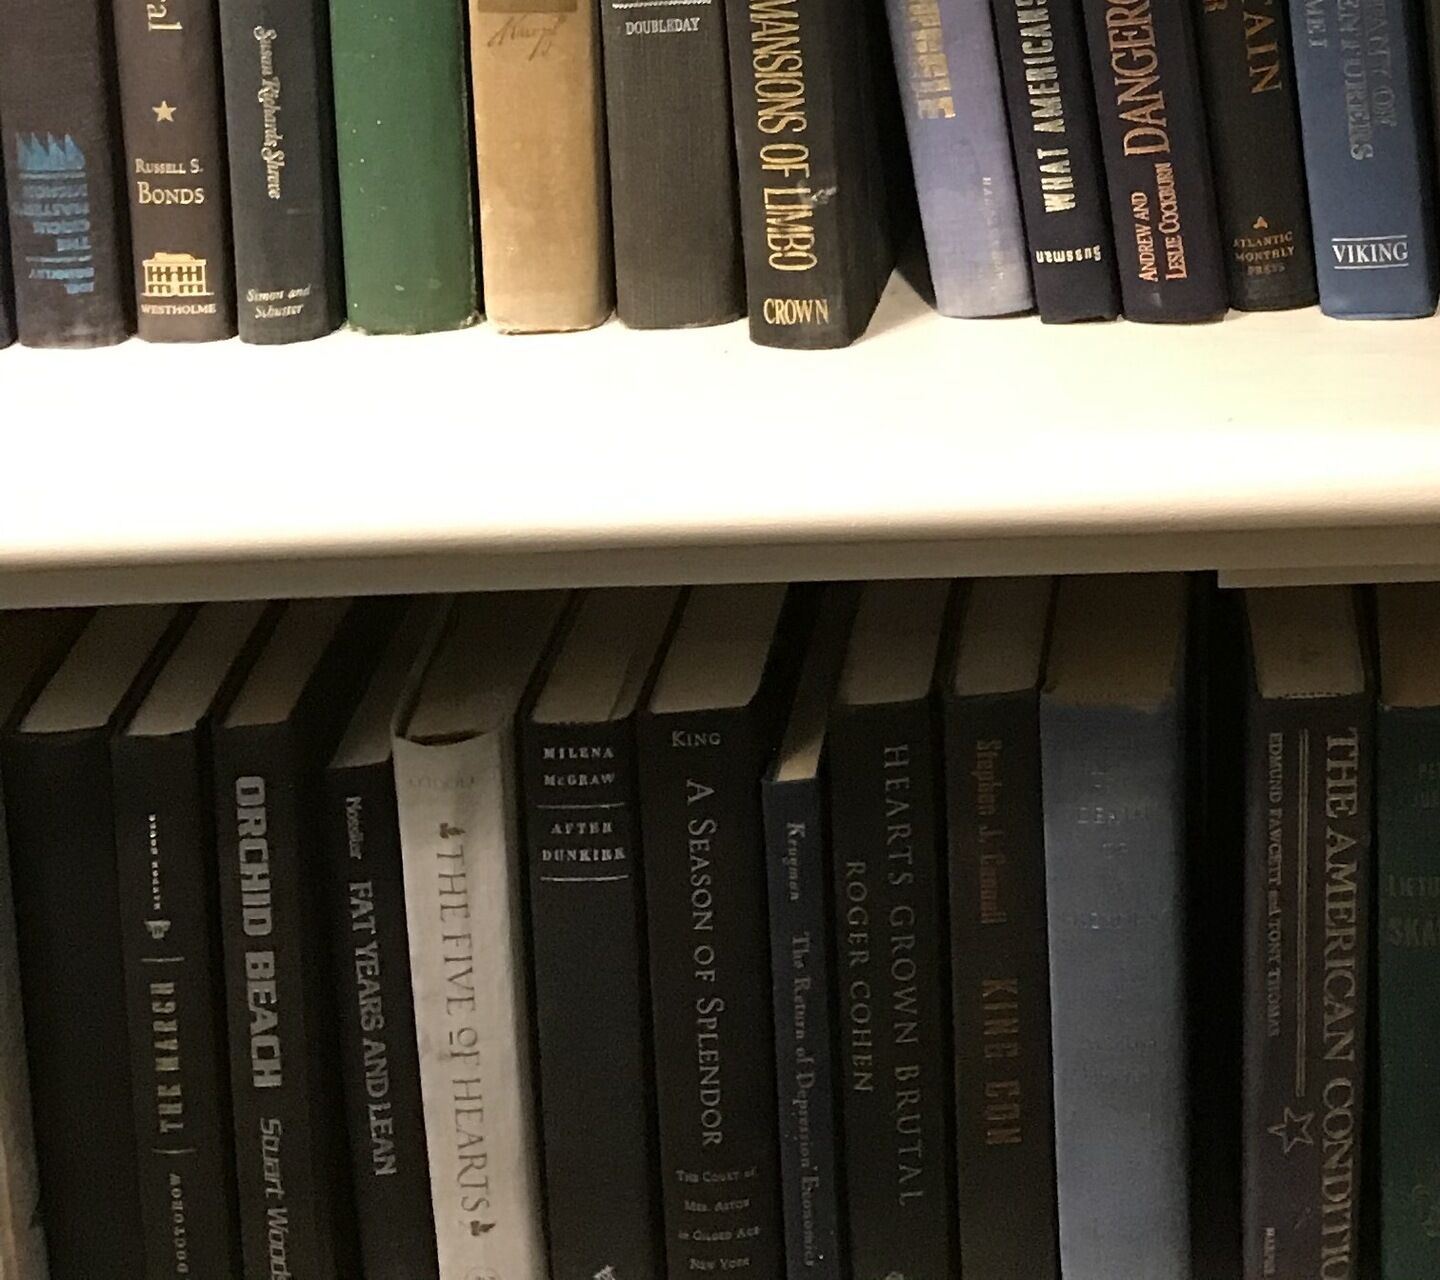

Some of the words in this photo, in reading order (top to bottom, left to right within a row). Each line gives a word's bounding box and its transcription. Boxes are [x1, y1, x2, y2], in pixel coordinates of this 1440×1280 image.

[624, 17, 701, 36] DOUBLEDAY
[758, 142, 811, 179] OF
[1035, 147, 1077, 214] WHAT
[762, 187, 818, 272] LIMBO
[1331, 241, 1410, 264] VIKING
[761, 297, 832, 326] CROWN
[671, 731, 721, 748] KING
[685, 779, 715, 807] A
[883, 744, 914, 886] HEARTS
[234, 775, 274, 937] ORCHID
[436, 844, 472, 923] THE
[687, 816, 719, 933] SEASON
[847, 861, 870, 966] ROGER
[441, 933, 477, 1017] FIVE
[692, 944, 717, 983] OF
[889, 905, 920, 1044] GROWN
[244, 950, 284, 1088] BEACH
[449, 1027, 481, 1067] OF
[850, 980, 874, 1091] COHEN
[695, 996, 727, 1149] SPLENDOR
[451, 1077, 491, 1213] HEARTS
[893, 1064, 925, 1207] BRUTAL
